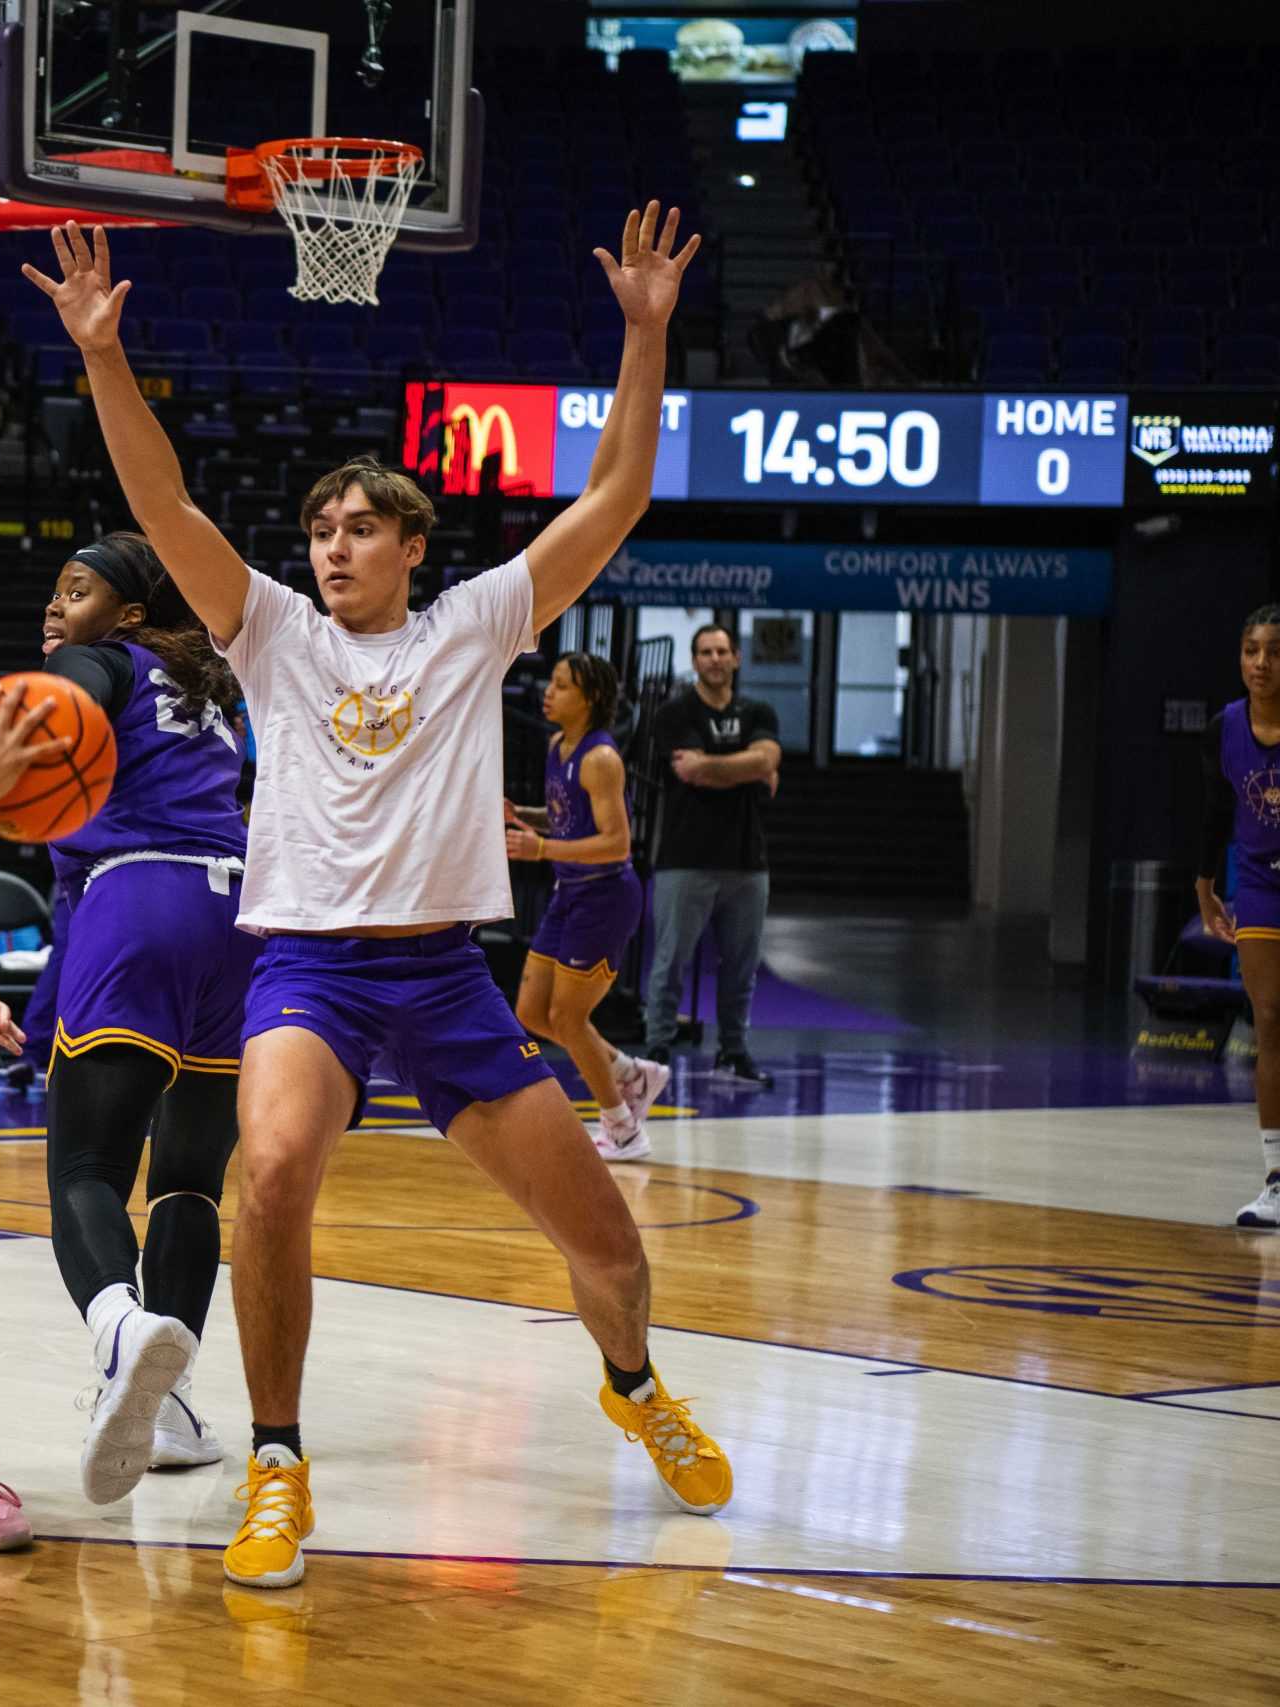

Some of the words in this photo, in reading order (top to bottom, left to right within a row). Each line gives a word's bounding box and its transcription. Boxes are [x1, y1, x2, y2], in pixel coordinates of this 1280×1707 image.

[34, 160, 80, 179] SPALDING
[560, 393, 687, 430] GUT
[996, 399, 1117, 436] HOME
[730, 409, 940, 487] 14:50
[1140, 427, 1172, 450] NTS
[1037, 447, 1070, 495] 0
[634, 559, 773, 596] accutemp
[823, 550, 952, 577] COMFORT
[961, 554, 1069, 579] ALWAYS
[895, 577, 991, 609] WINS
[519, 1041, 541, 1059] LS
